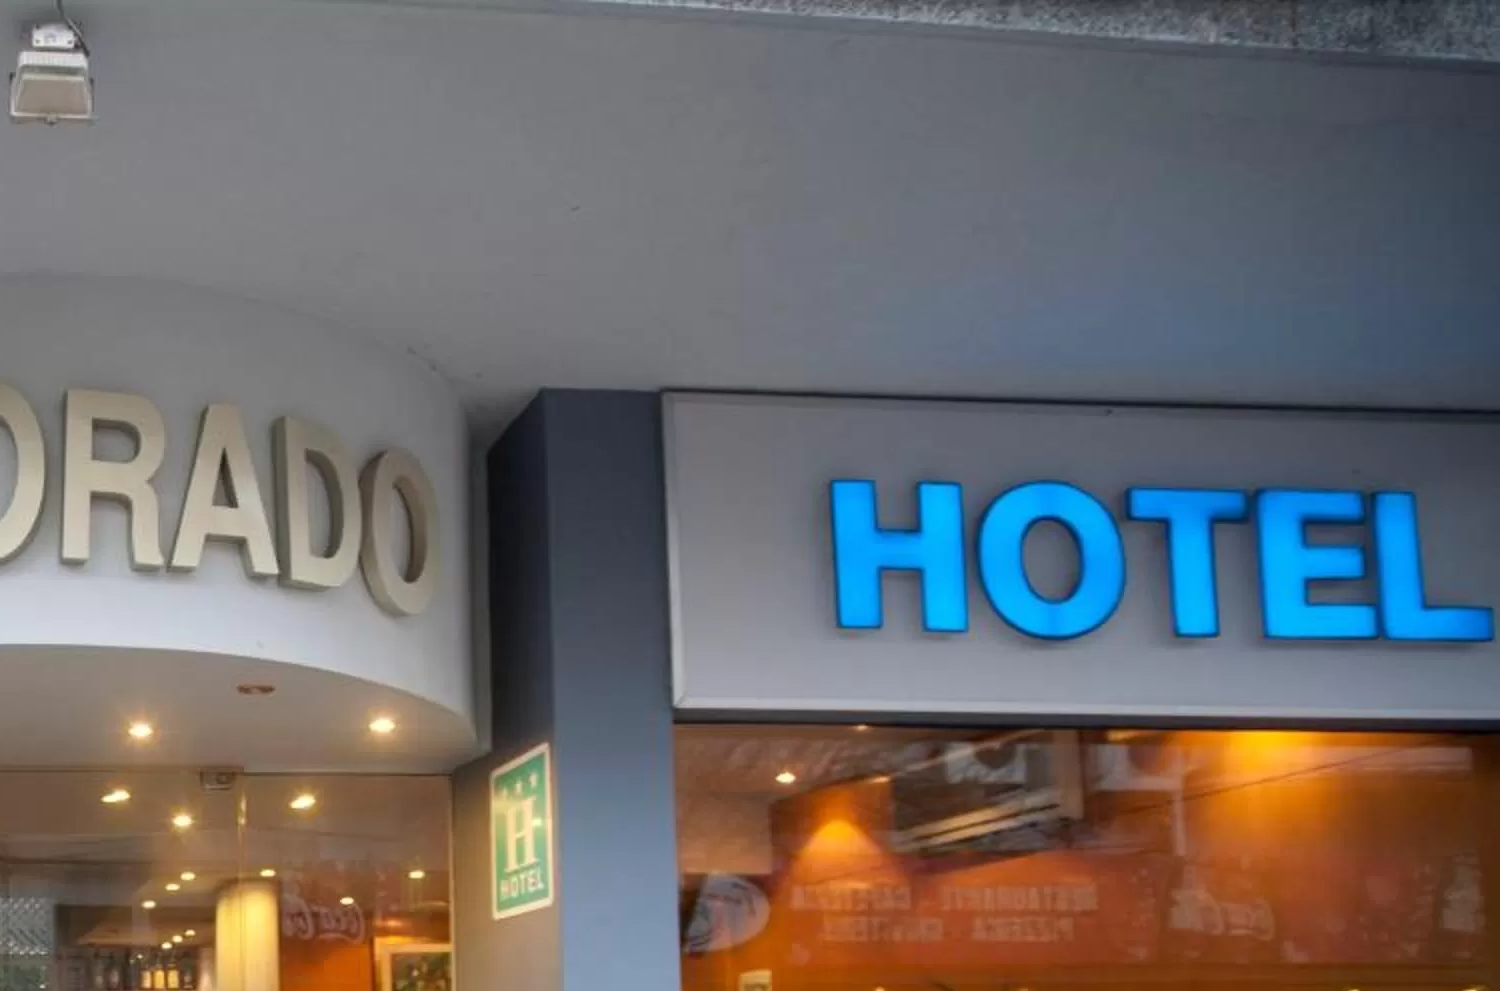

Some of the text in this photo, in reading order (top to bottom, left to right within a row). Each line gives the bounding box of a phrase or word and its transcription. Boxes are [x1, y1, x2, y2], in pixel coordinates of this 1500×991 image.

[830, 478, 1494, 641] HOTEL
[504, 796, 540, 874] H
[500, 868, 545, 901] HOTEL
